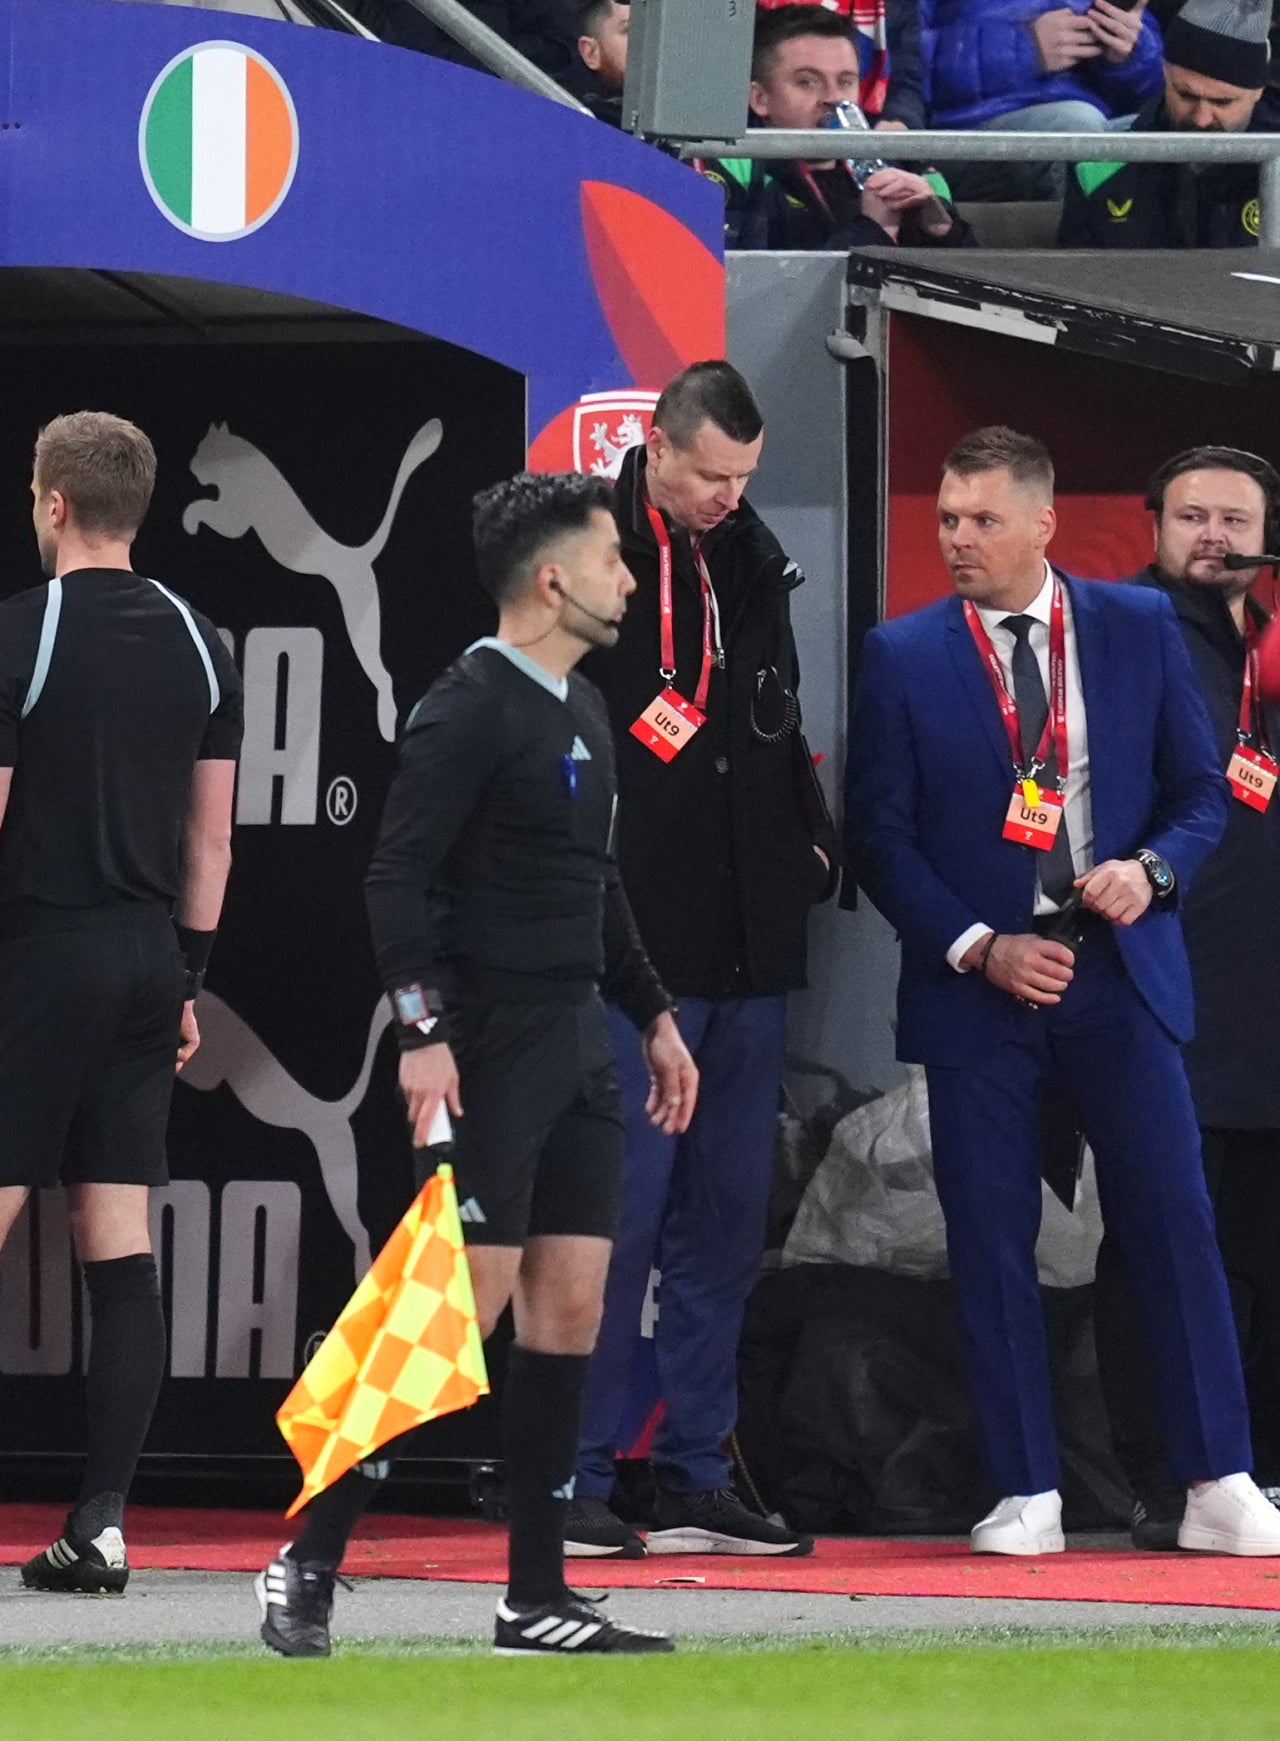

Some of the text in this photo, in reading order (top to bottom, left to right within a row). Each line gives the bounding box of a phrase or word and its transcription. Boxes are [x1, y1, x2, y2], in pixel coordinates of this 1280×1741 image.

[654, 712, 680, 737] Ut9
[1238, 768, 1263, 788] Ut9
[1020, 807, 1048, 825] Ut9
